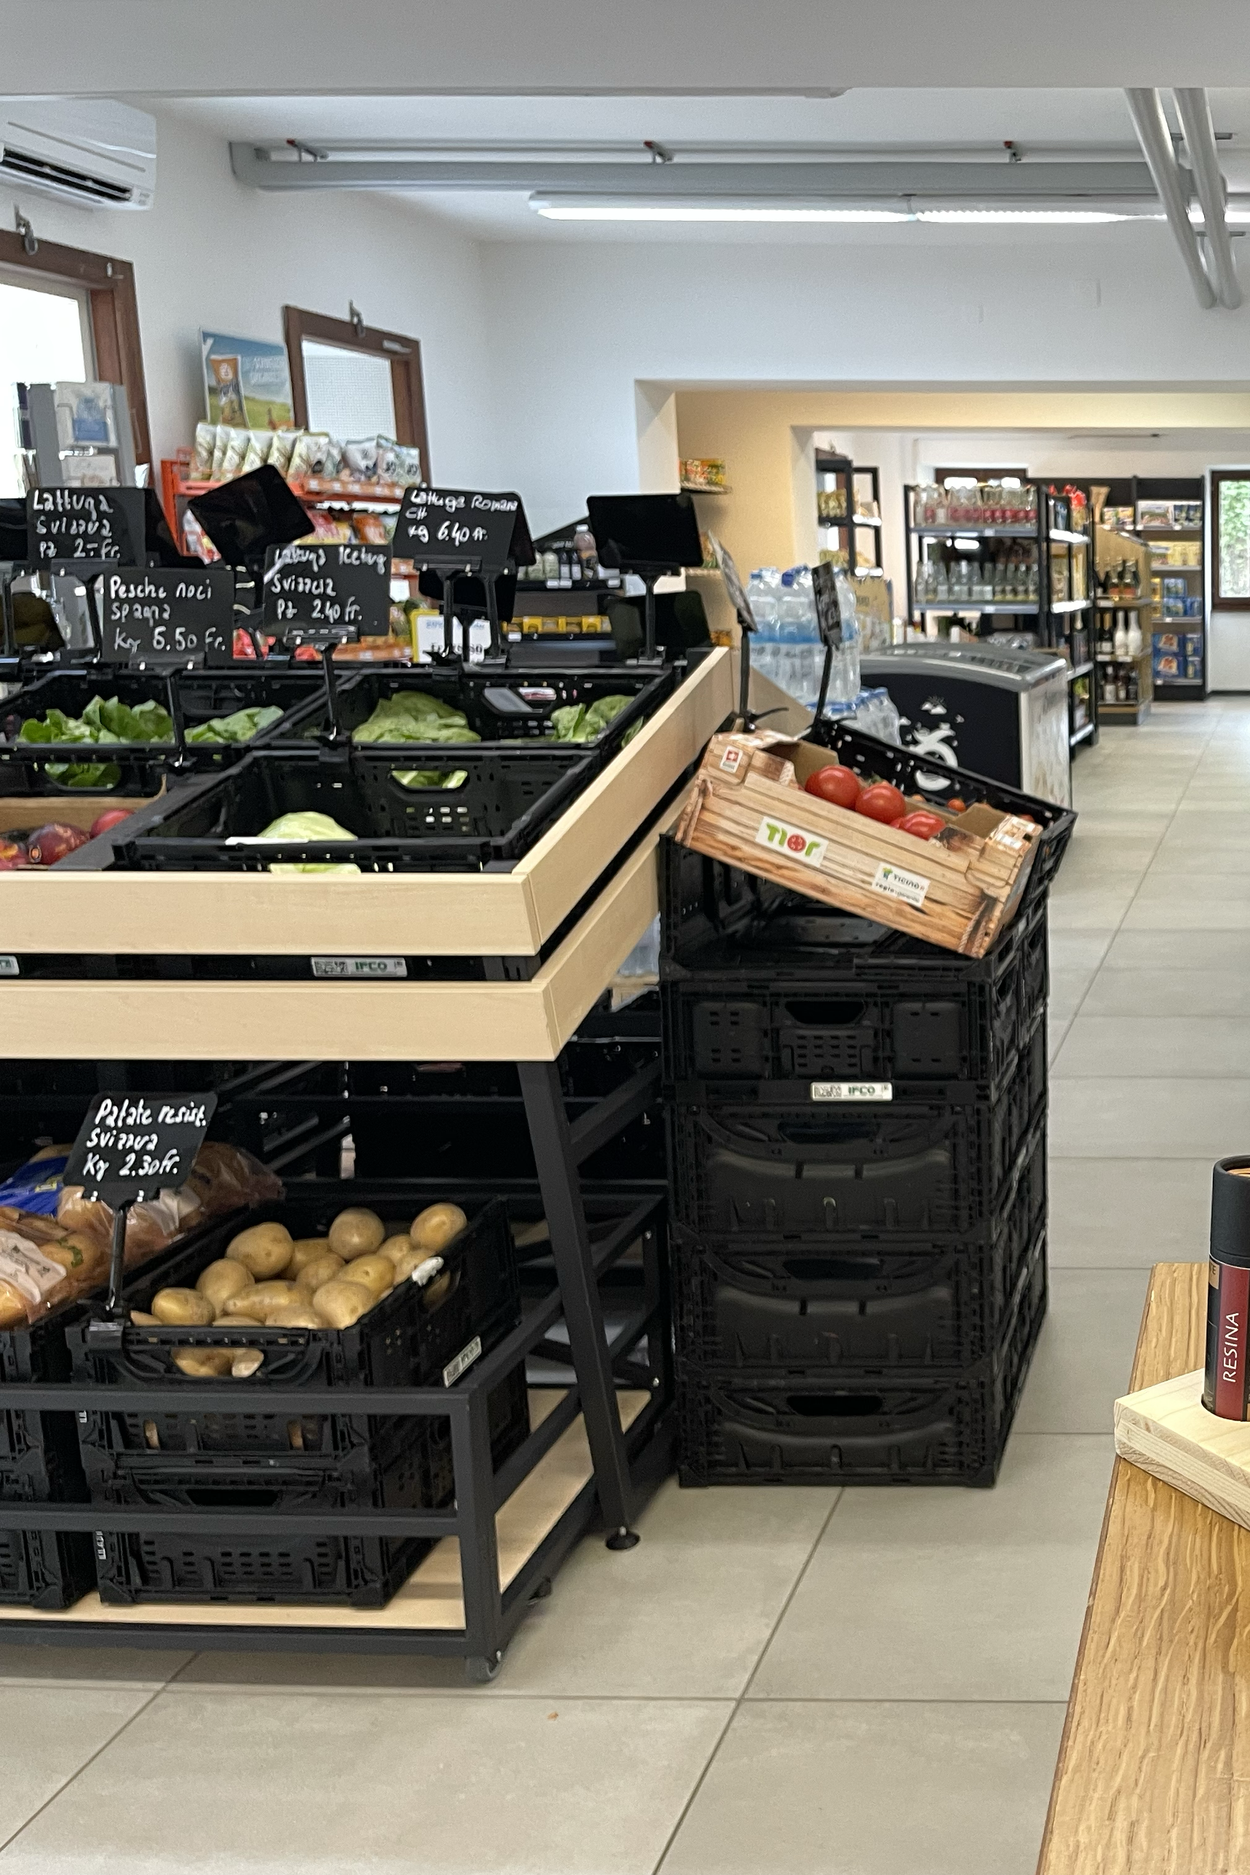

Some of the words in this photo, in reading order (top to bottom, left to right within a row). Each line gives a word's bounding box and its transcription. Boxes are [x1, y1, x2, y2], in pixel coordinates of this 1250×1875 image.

[33, 489, 113, 520] Lattuga
[110, 575, 167, 599] Pesche
[176, 579, 212, 600] noci
[311, 598, 340, 624] 2.40
[95, 1098, 153, 1128] Patate
[1222, 1312, 1240, 1382] RESINA
